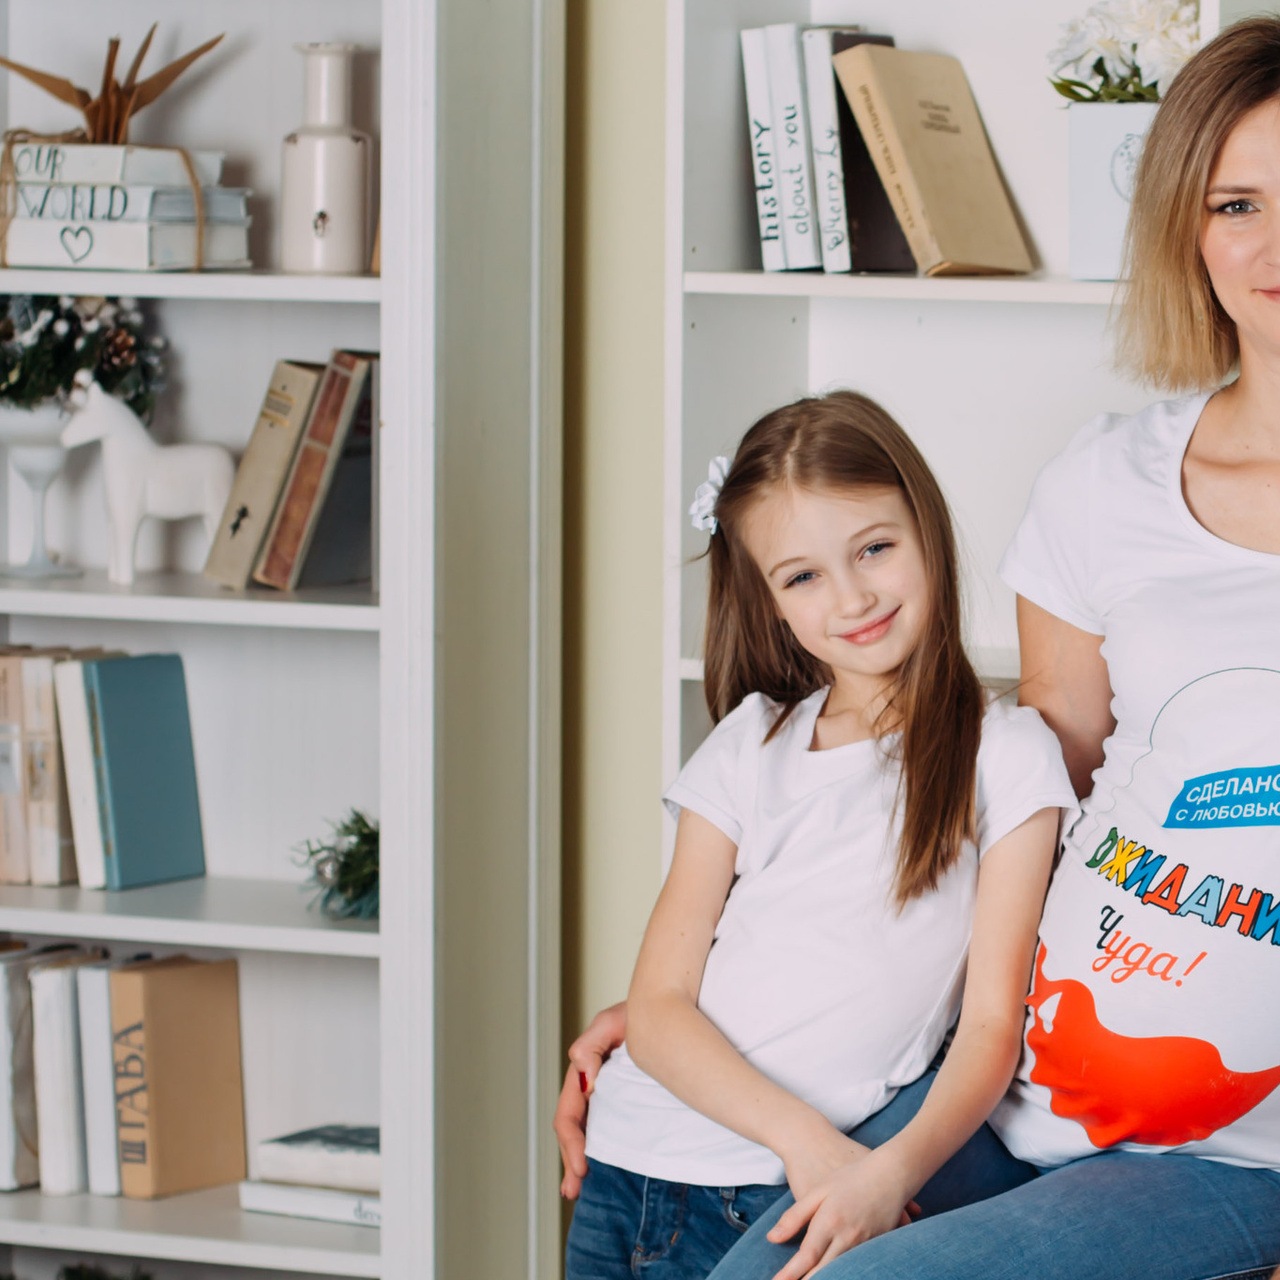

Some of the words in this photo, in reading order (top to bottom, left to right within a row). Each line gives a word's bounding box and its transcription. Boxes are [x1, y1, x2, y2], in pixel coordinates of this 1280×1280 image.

[15, 145, 66, 181] OUR
[20, 185, 128, 220] WORLD
[783, 163, 809, 235] about
[1092, 905, 1207, 987] Чуда!
